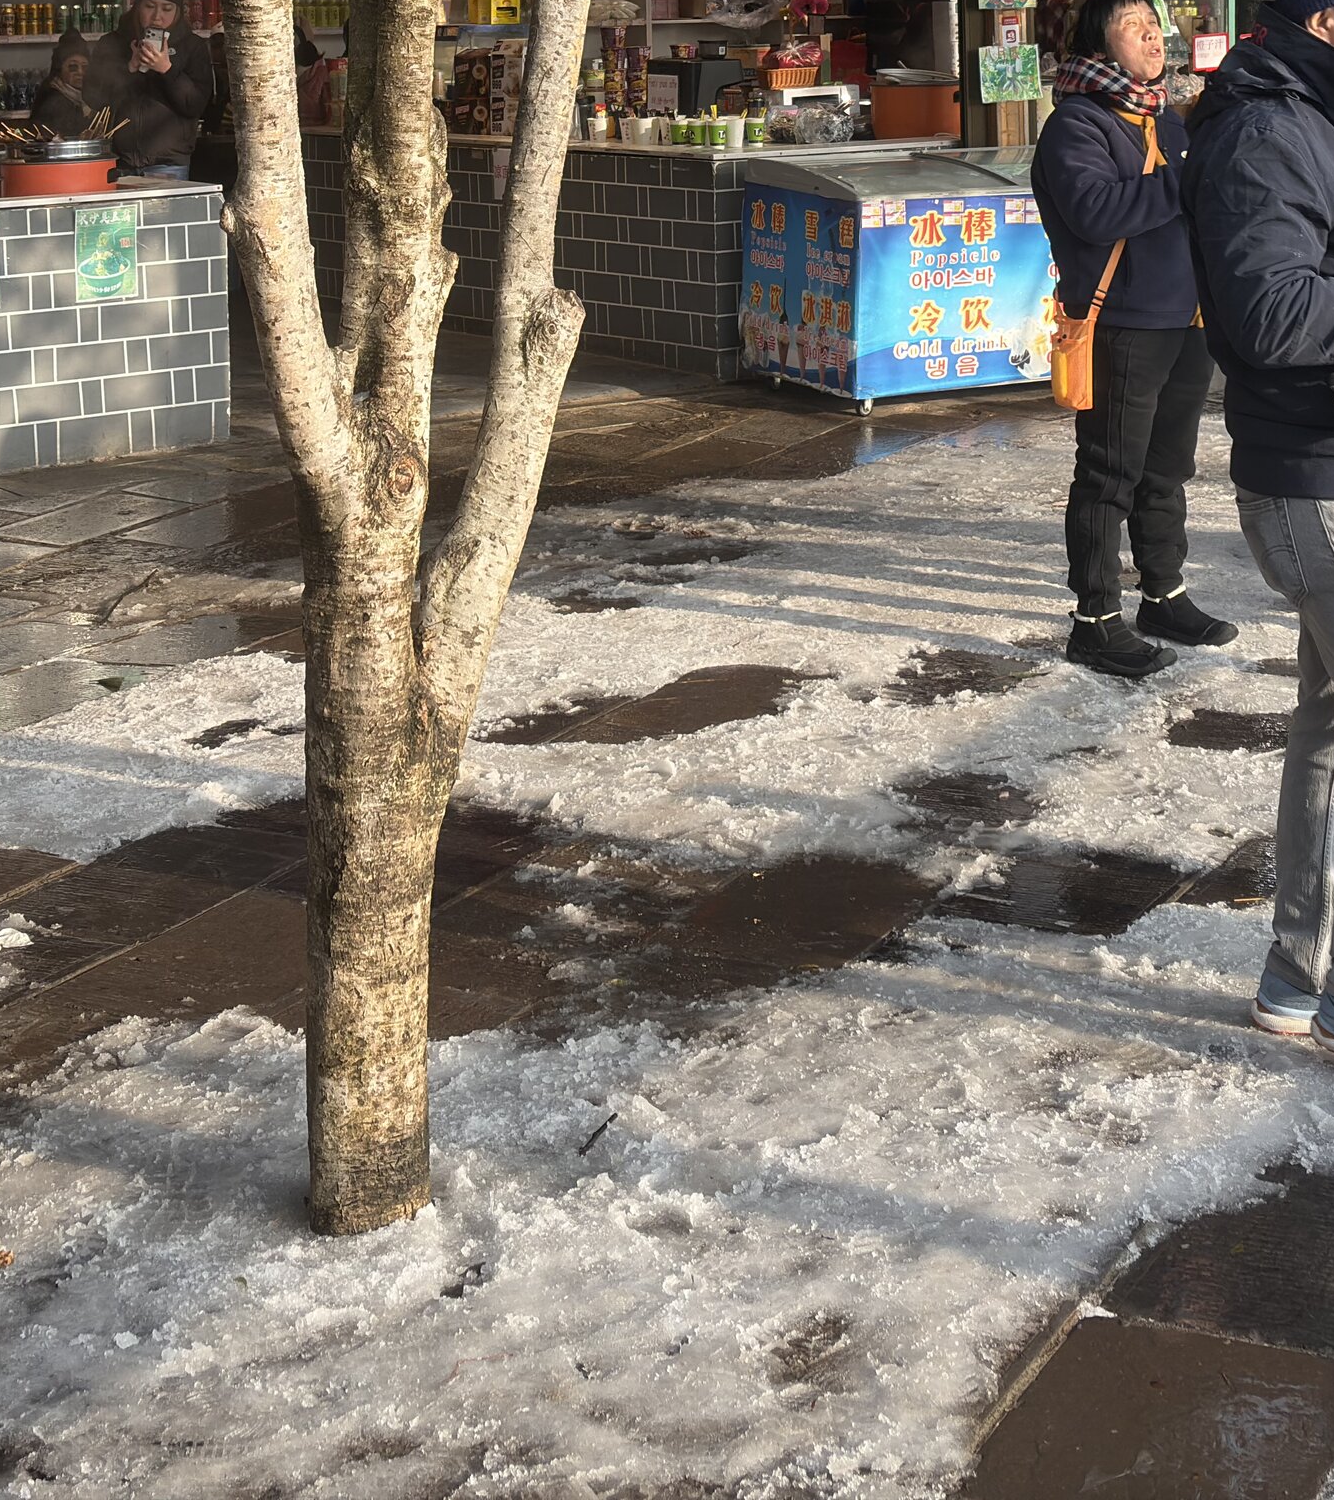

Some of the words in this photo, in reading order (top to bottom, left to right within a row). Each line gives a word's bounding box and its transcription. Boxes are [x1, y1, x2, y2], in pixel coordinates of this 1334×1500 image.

[751, 199, 786, 235] 冰棒
[804, 208, 855, 249] 雪糕
[909, 207, 996, 248] 冰棒
[750, 250, 785, 272] 아이스바
[910, 246, 1000, 268] Popsicle
[911, 265, 995, 289] 아이스바
[750, 280, 783, 317] 冷饮
[802, 292, 852, 334] 冰淇淋
[908, 296, 994, 337] 冷饮
[893, 338, 943, 360] Cold
[950, 335, 1009, 355] drink
